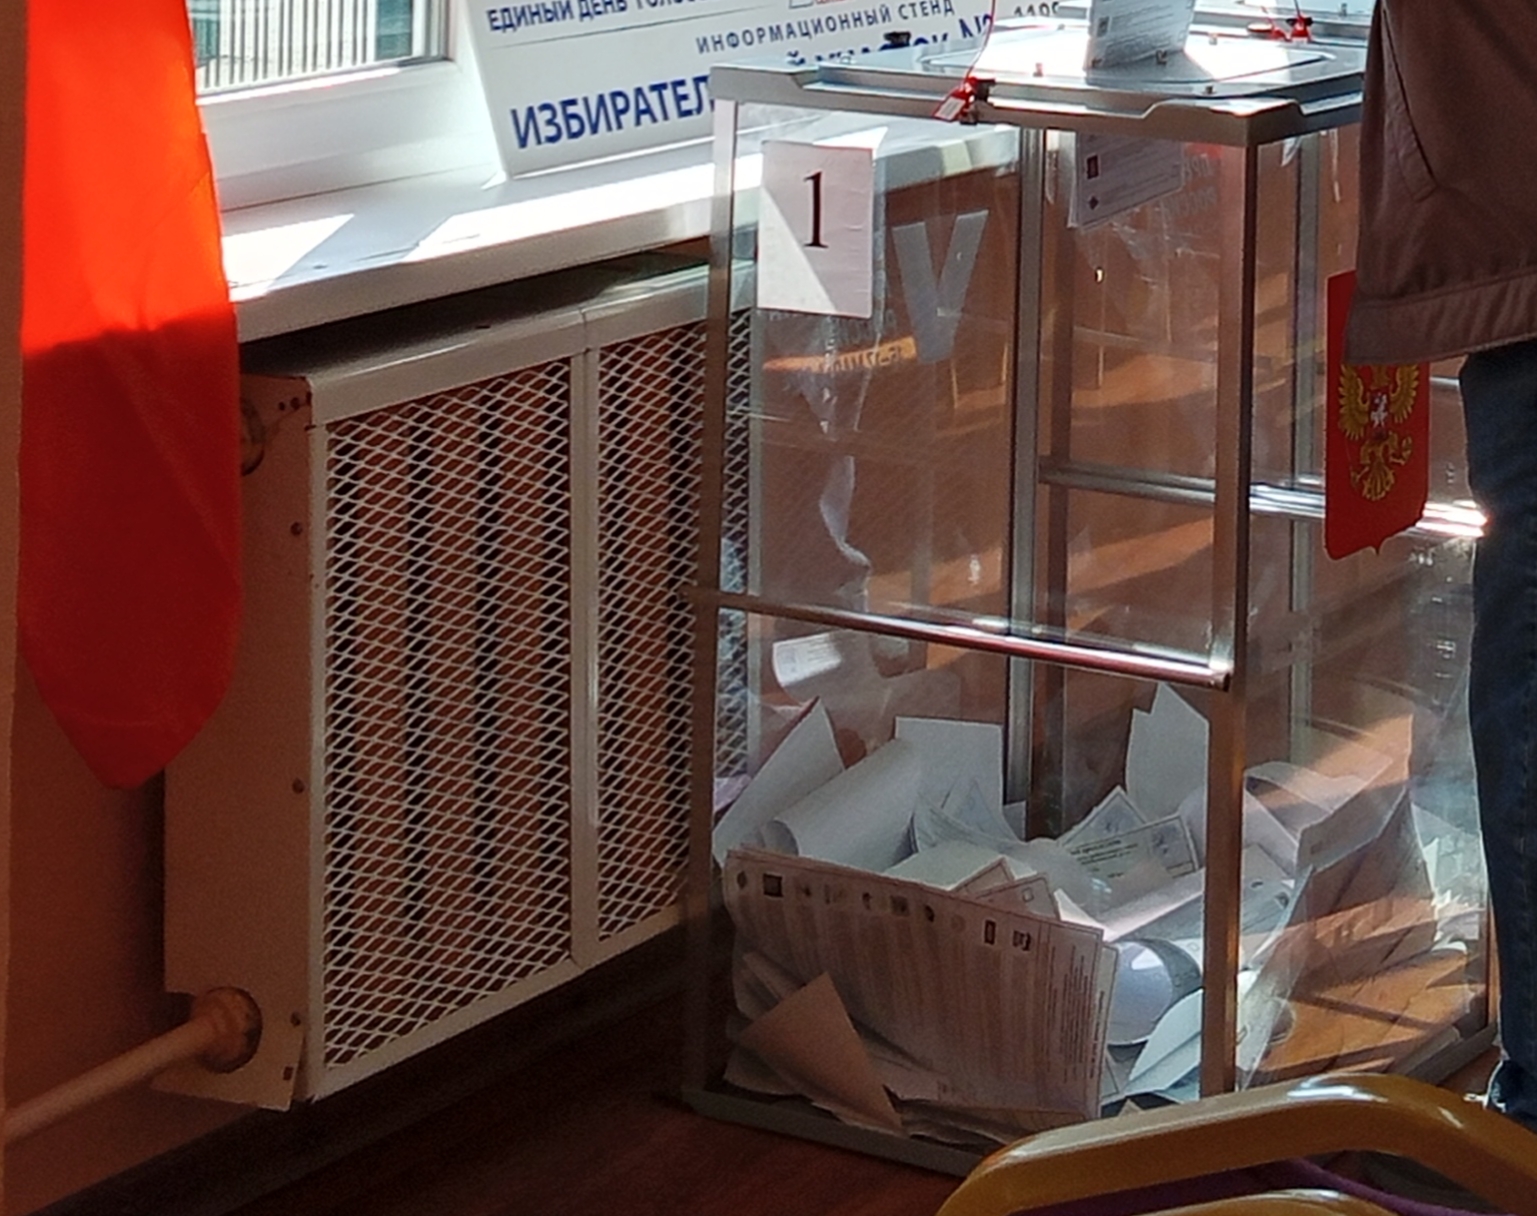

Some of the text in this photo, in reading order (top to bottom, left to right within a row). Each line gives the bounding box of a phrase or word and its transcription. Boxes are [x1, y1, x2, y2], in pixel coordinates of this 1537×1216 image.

[696, 3, 892, 54] ИНФОРМАЦИОННЫЙ
[511, 74, 715, 150] ИЗБИРАТЕЛ
[802, 171, 829, 248] 1
